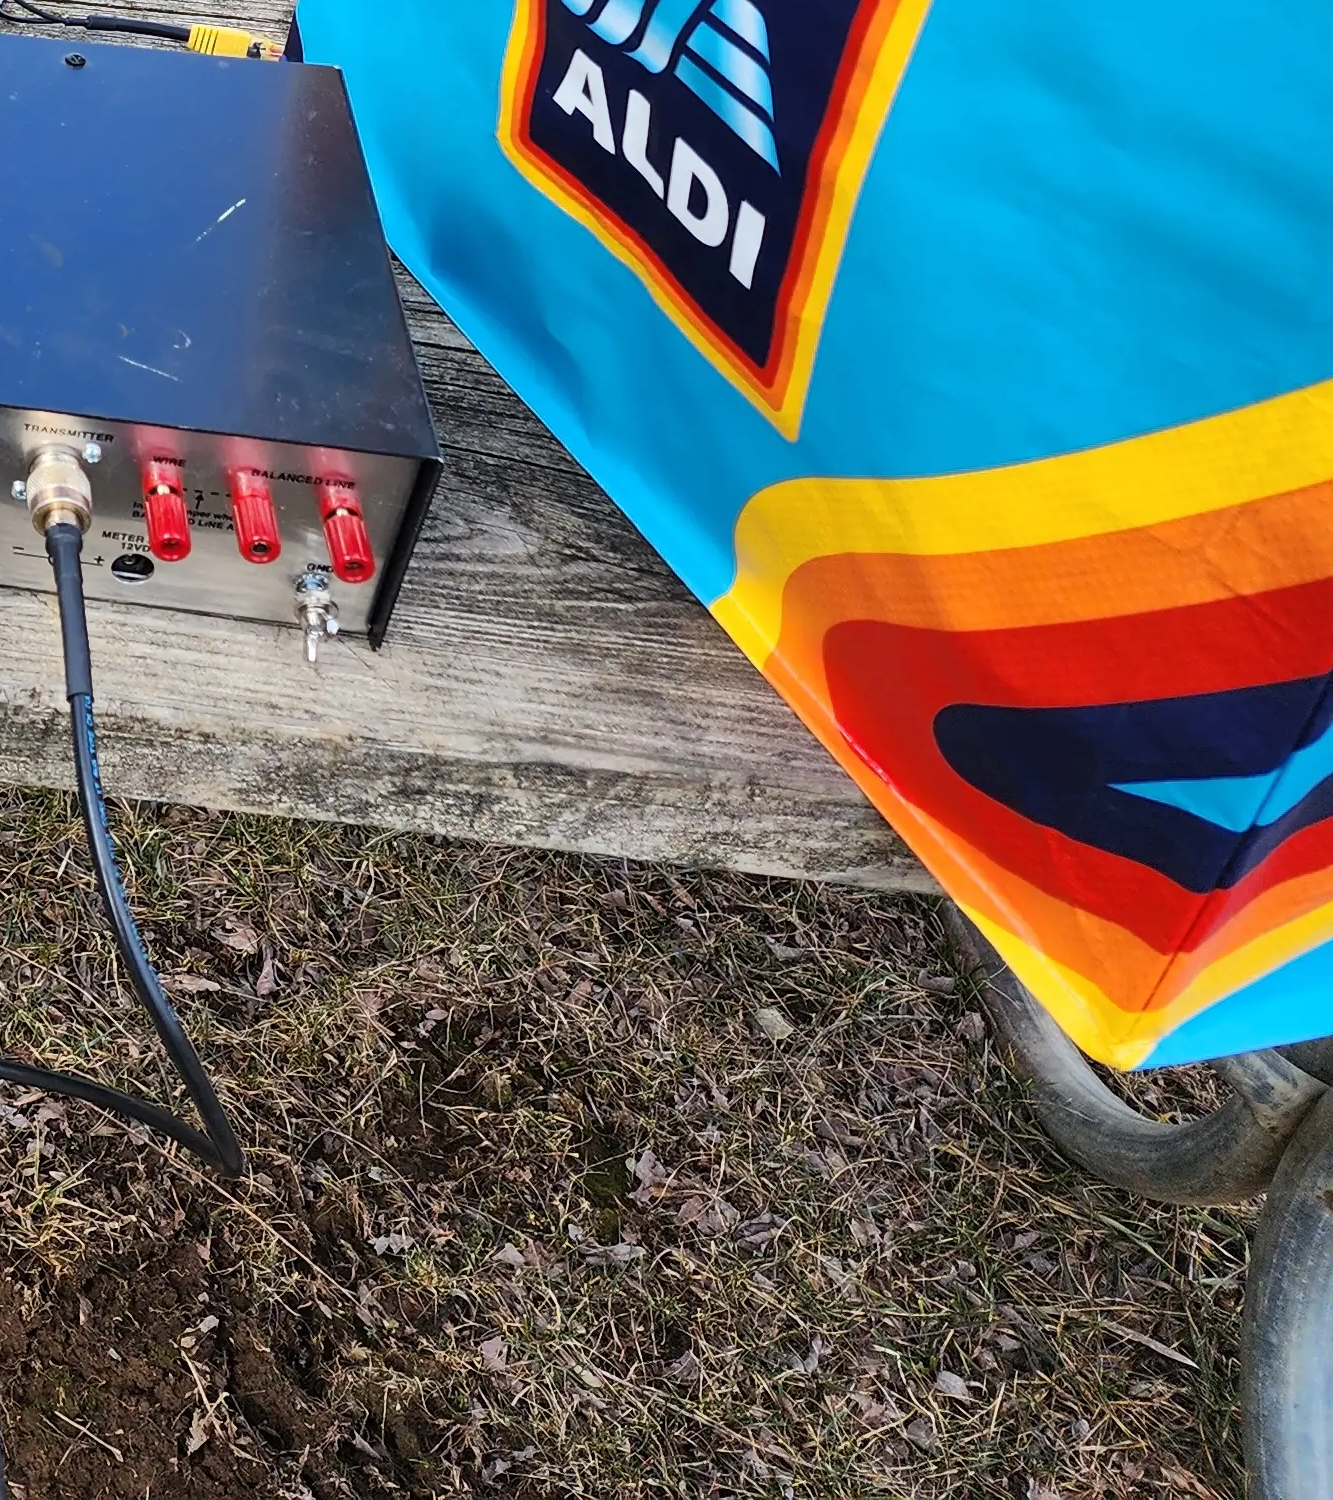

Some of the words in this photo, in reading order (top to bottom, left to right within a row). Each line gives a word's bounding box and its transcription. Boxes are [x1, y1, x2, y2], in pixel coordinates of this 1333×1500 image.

[551, 46, 768, 291] ALDI
[24, 422, 114, 444] TRANSMITTER
[152, 455, 187, 468] WIRE
[251, 468, 323, 487] BALANCED
[325, 477, 356, 491] LINE
[102, 530, 145, 543] METER
